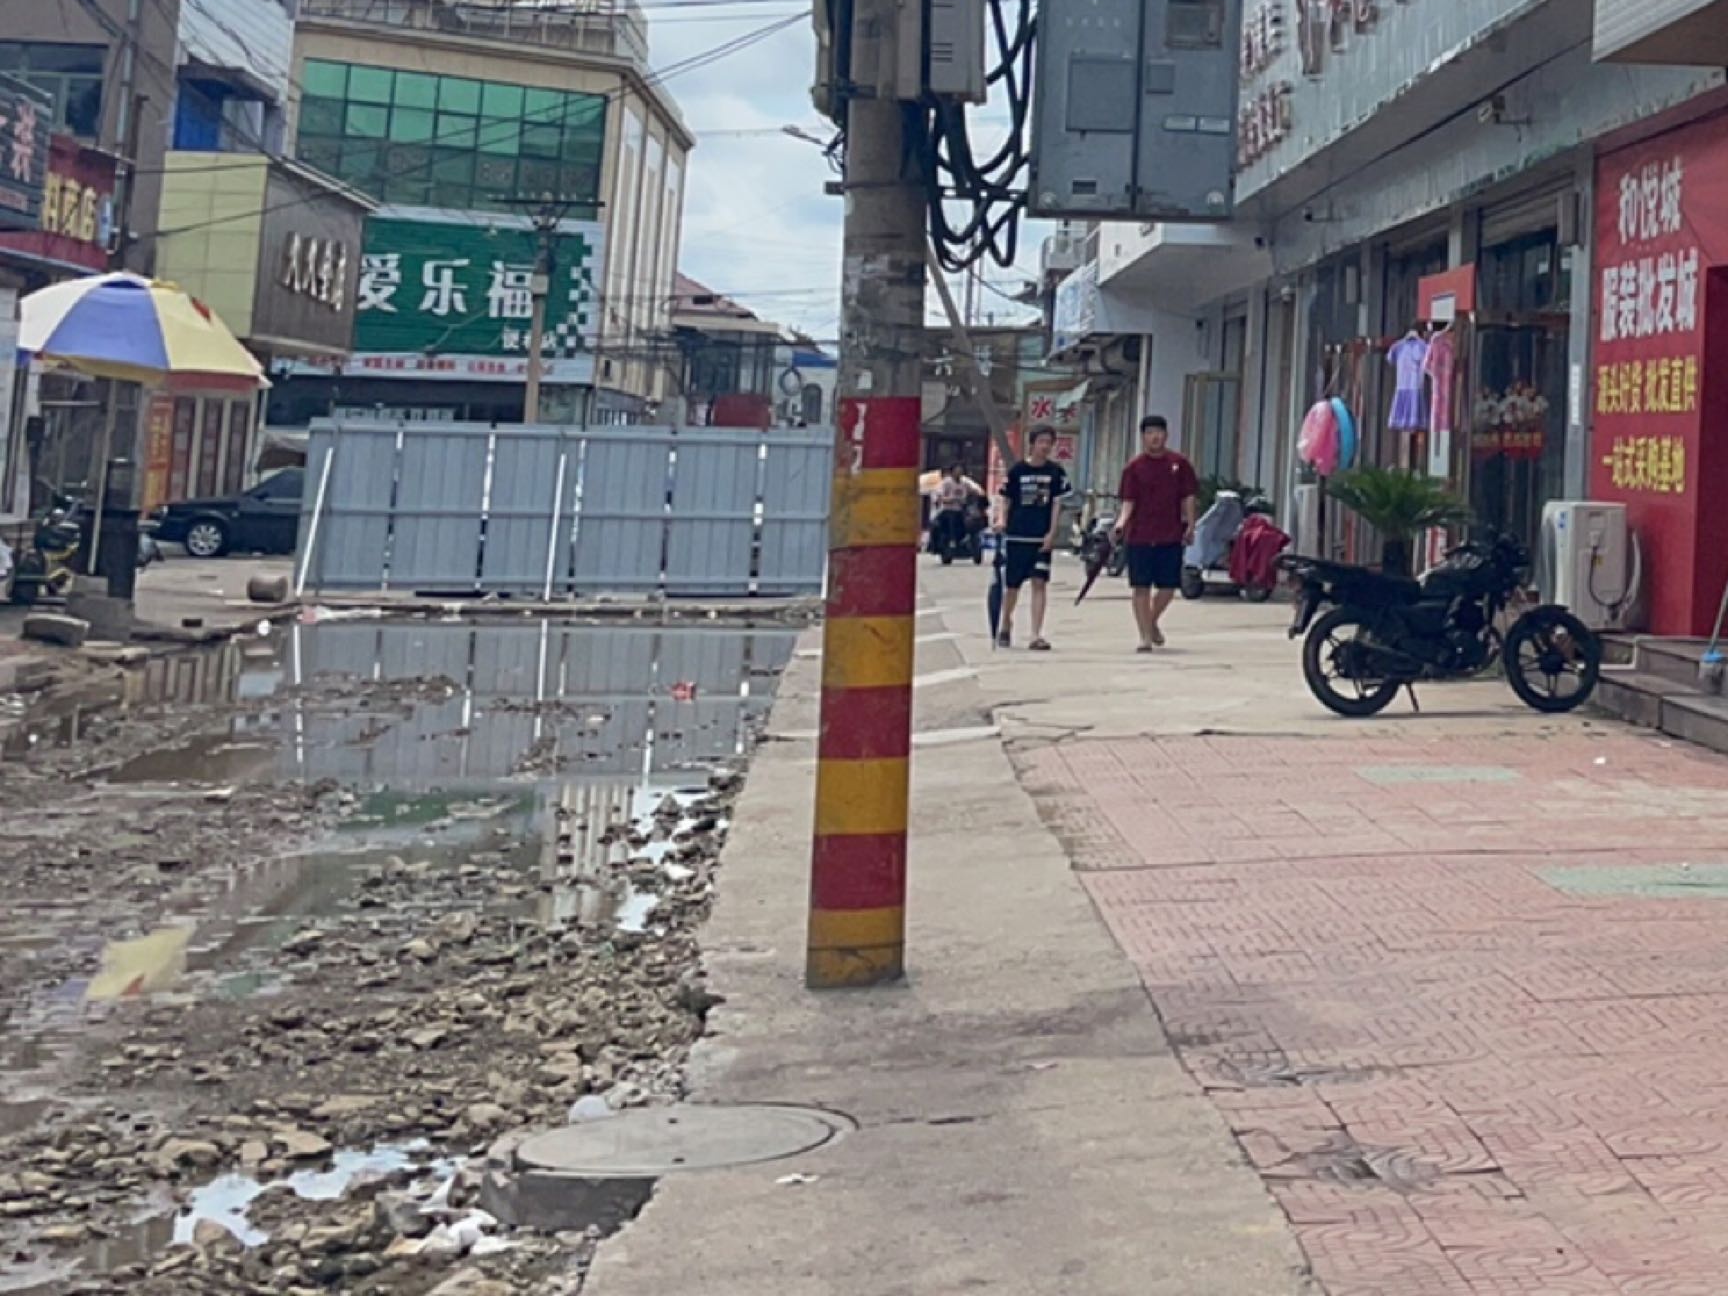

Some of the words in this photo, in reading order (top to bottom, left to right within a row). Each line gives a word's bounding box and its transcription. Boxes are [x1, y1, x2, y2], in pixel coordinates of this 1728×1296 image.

[357, 253, 536, 318] 爱乐福
[1600, 246, 1699, 342] 服装批发城
